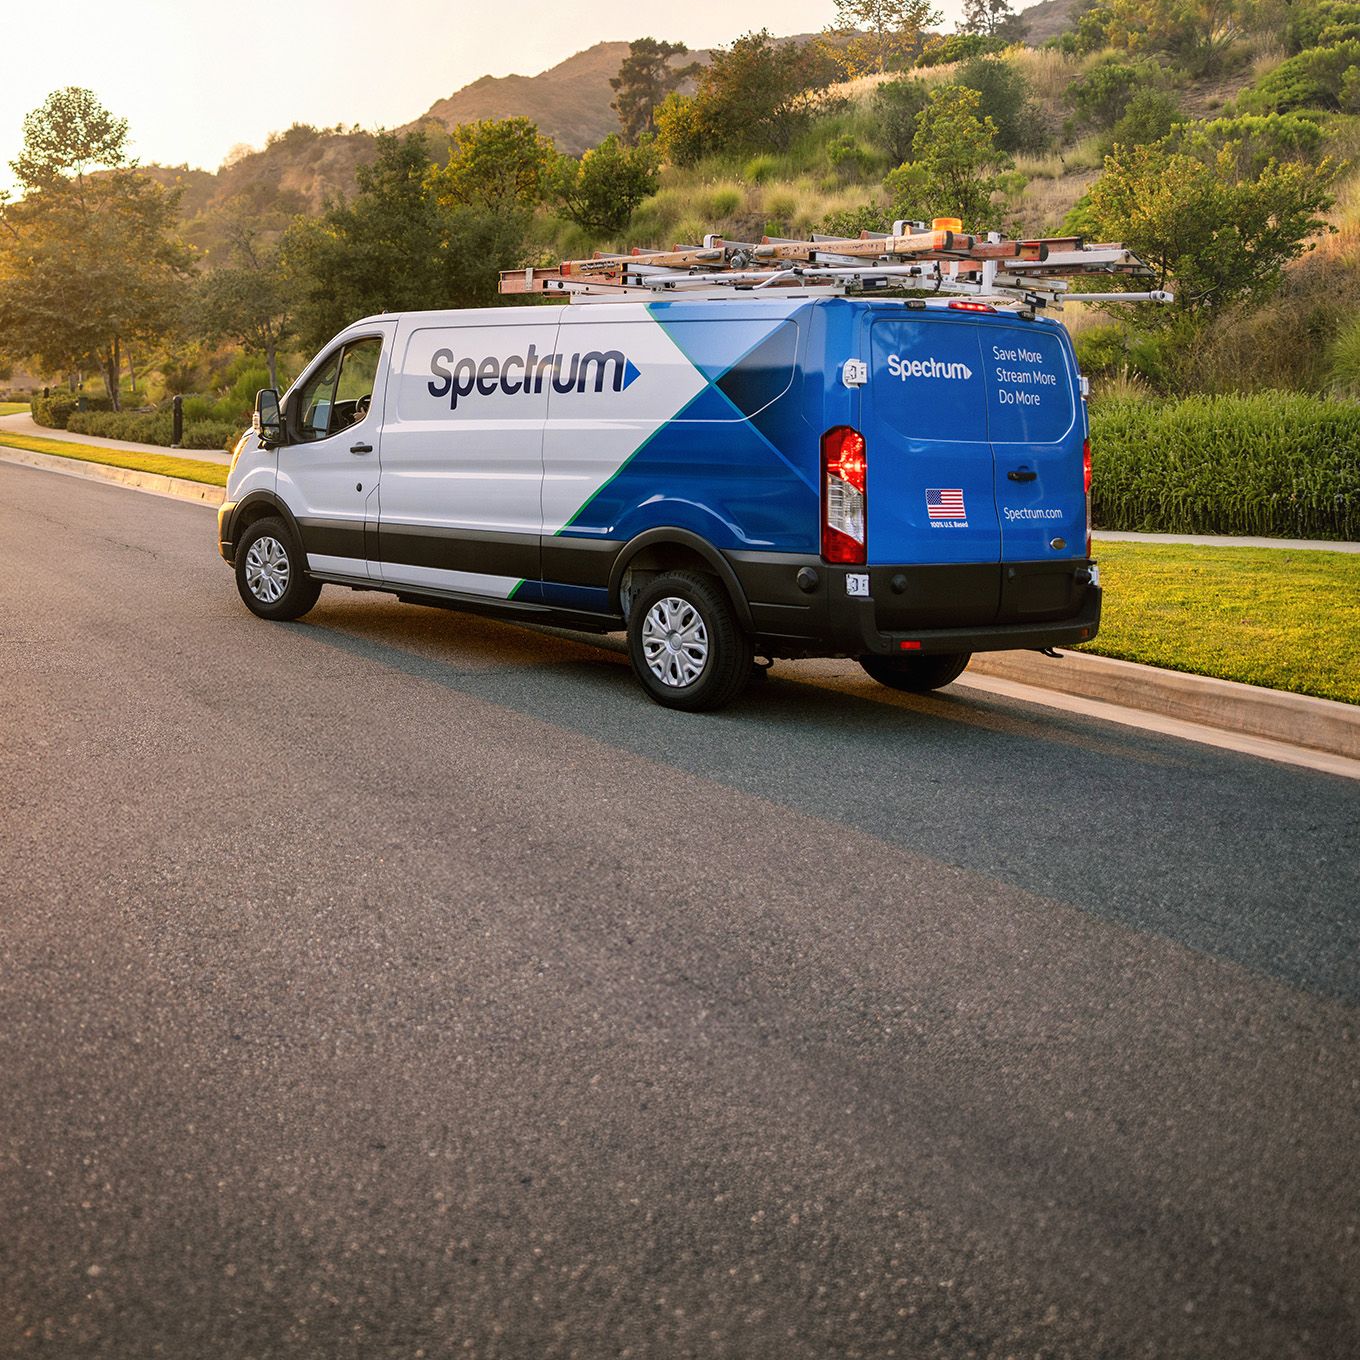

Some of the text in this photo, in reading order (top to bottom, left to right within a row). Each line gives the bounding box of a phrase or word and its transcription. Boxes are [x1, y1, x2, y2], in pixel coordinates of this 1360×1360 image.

[992, 346, 1042, 363] Save More
[427, 343, 625, 410] Spectrum
[887, 354, 968, 382] Spectrum
[996, 367, 1056, 385] Stream More
[999, 389, 1040, 406] Do More
[1003, 506, 1063, 522] Spectrum.com
